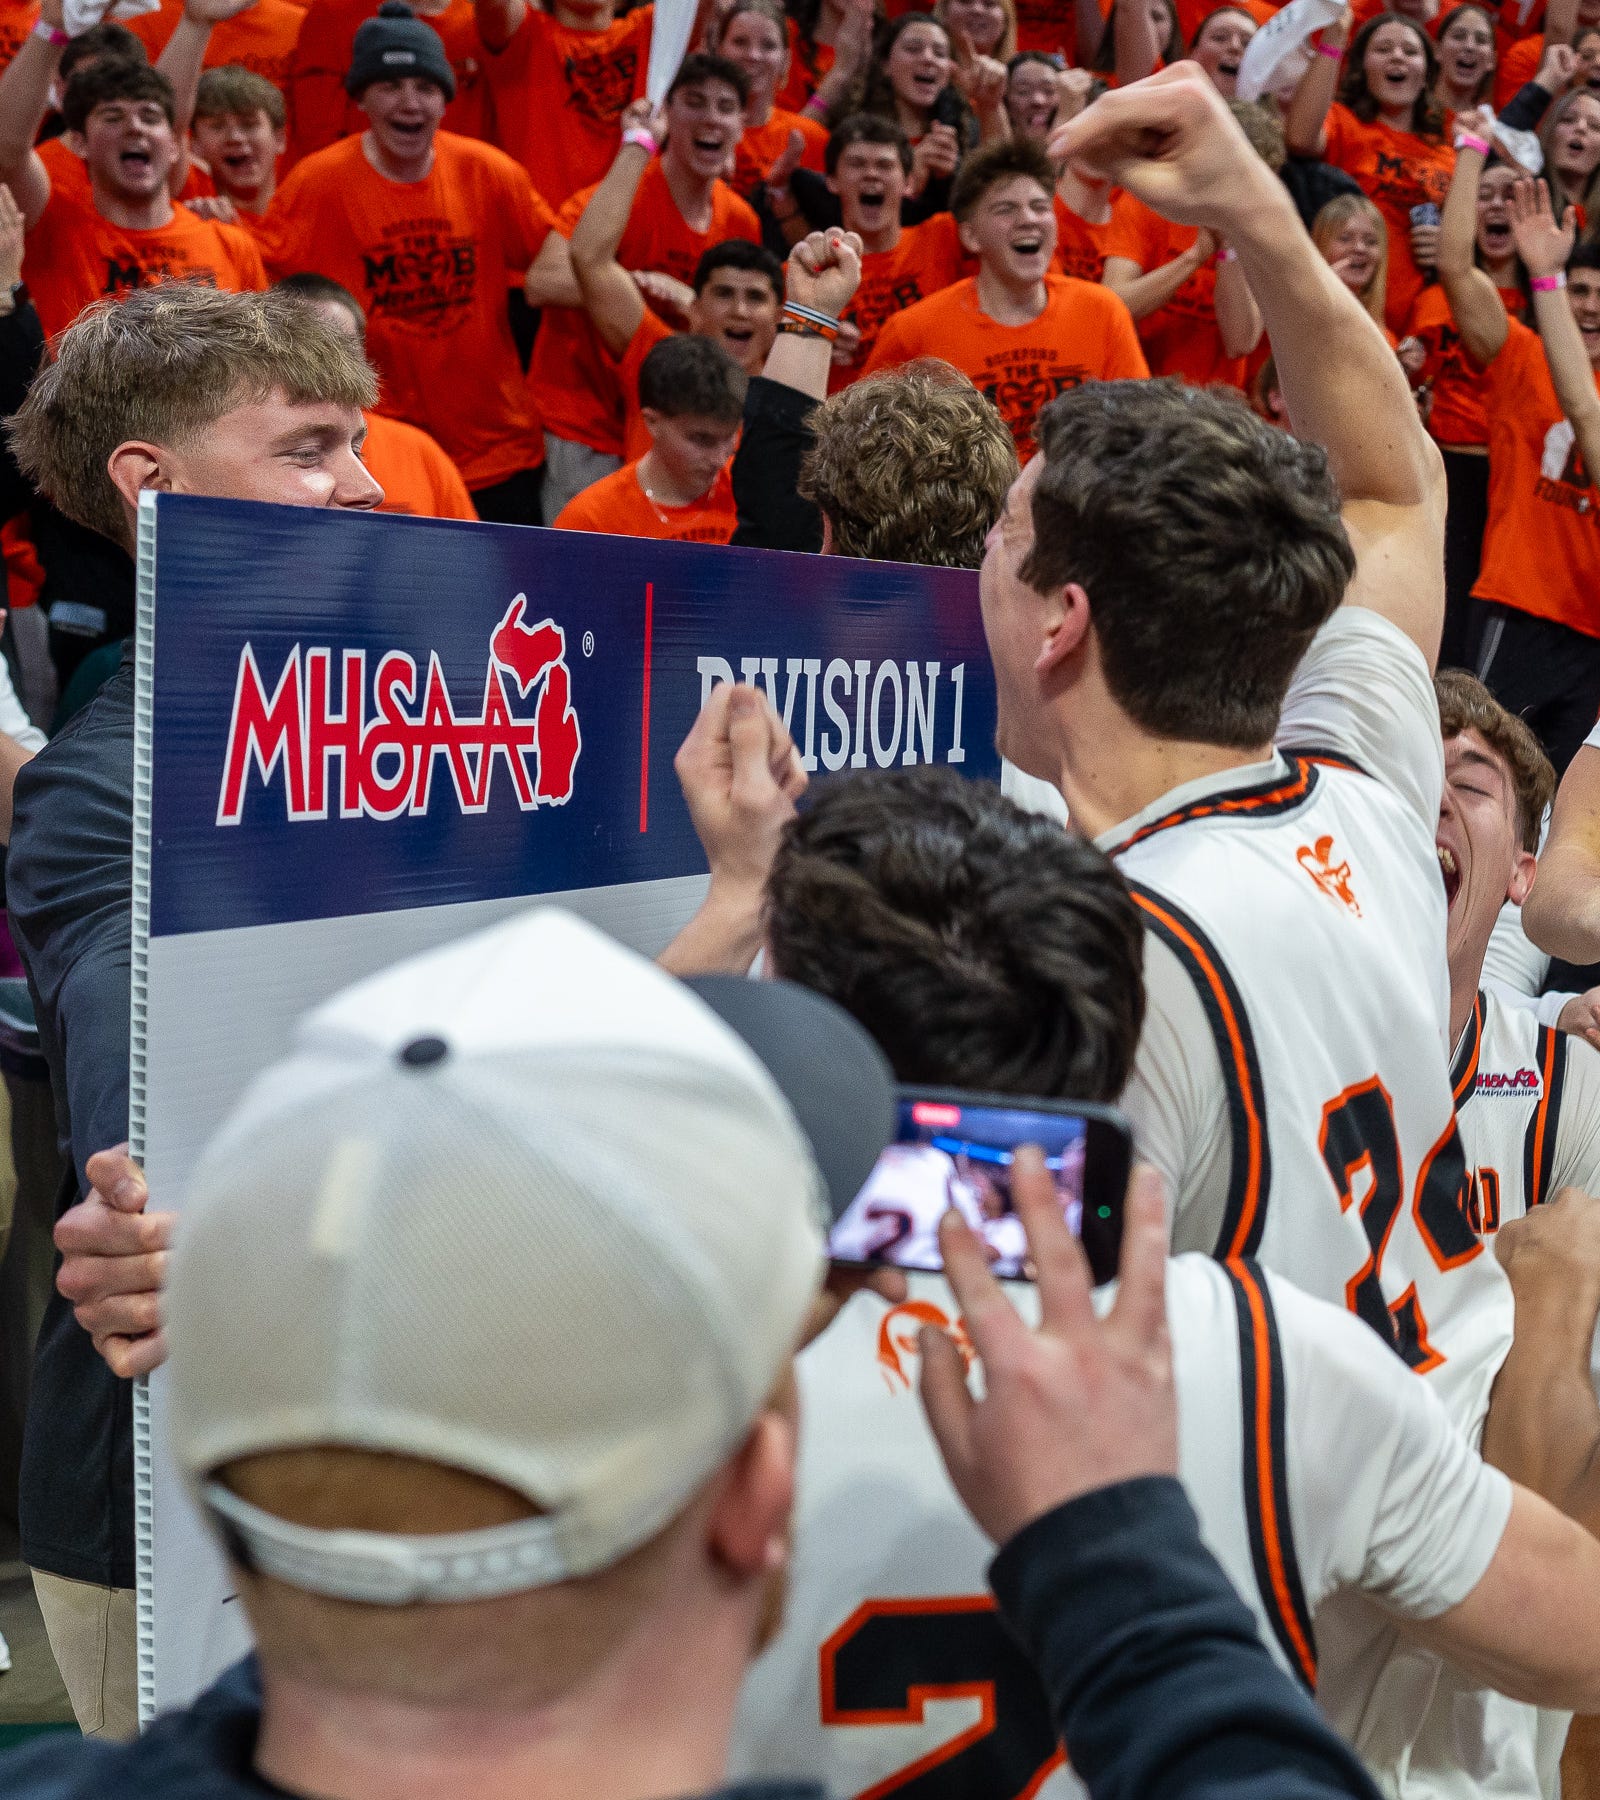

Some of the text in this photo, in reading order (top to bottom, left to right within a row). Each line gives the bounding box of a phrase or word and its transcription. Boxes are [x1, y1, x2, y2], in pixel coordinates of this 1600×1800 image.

[1005, 363, 1040, 379] THE
[216, 640, 540, 826] MHSAA
[947, 662, 966, 763] 1
[1475, 1088, 1540, 1098] AMPIONSHIPS
